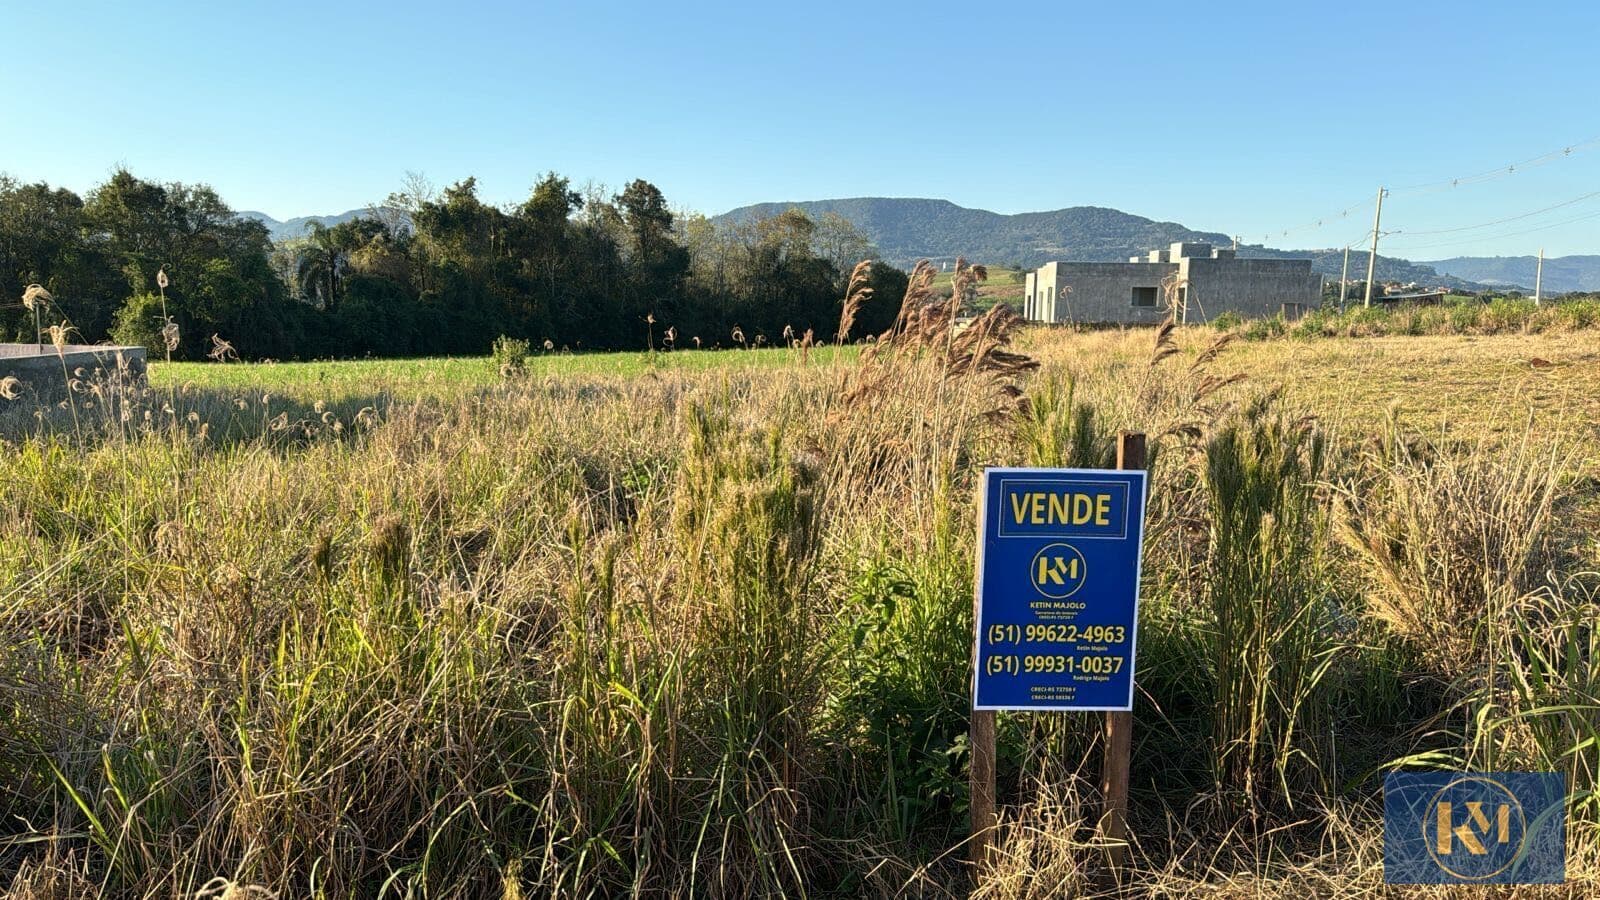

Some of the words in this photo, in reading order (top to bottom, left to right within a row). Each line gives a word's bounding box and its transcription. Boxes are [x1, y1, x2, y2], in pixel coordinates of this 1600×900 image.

[1011, 493, 1111, 525] VENDE
[1038, 557, 1078, 584] KM
[988, 624, 1021, 645] (51)
[1026, 624, 1125, 643] 99622-4963
[986, 655, 1019, 676] (51)
[1024, 655, 1124, 674] 99931-0037
